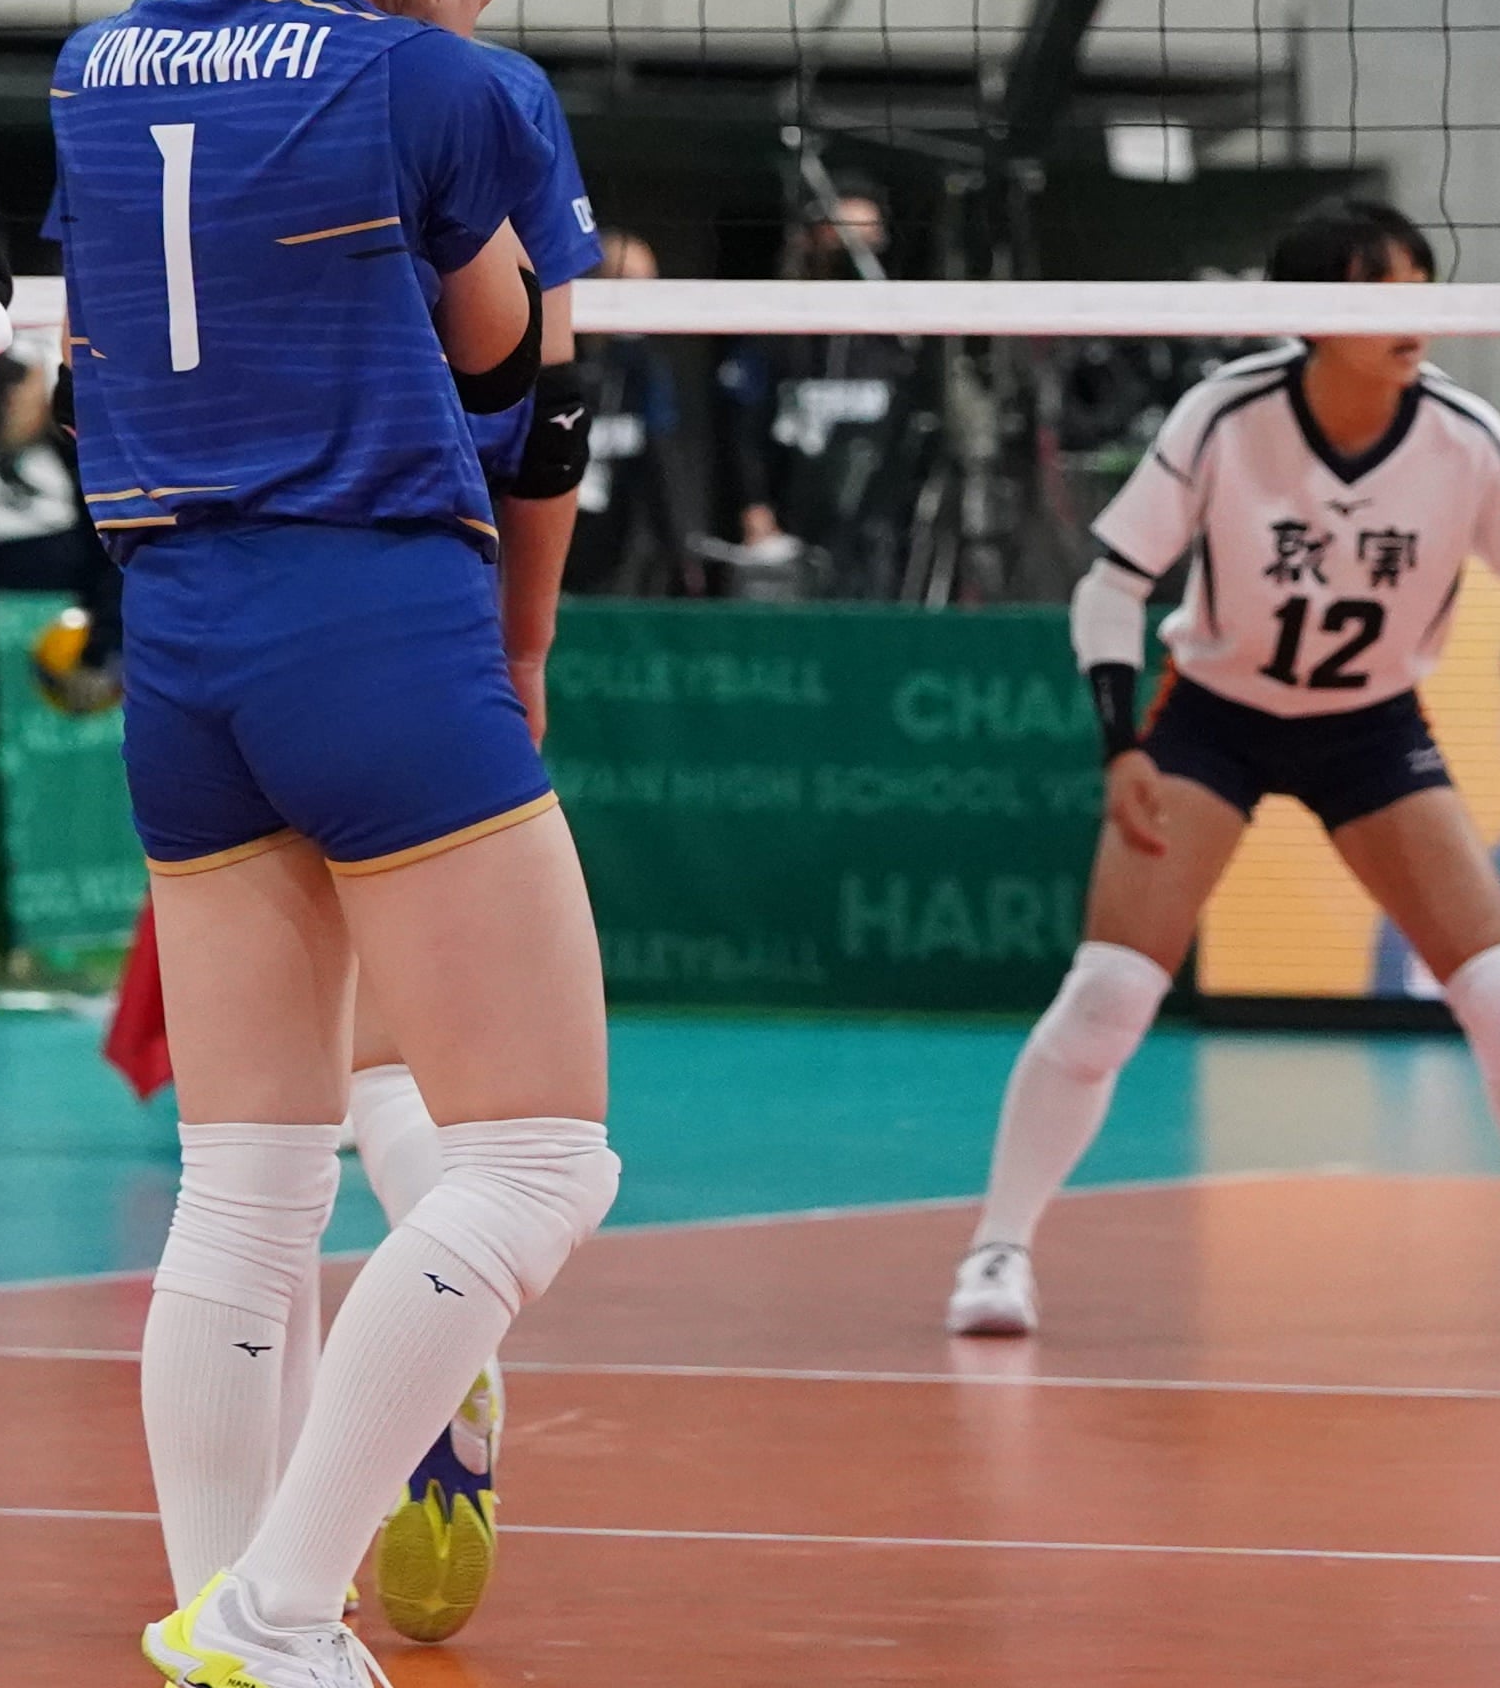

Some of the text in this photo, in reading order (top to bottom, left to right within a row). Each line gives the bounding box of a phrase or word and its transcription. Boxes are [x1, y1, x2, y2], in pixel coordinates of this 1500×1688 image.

[83, 23, 331, 88] KINRANKAI
[150, 123, 200, 372] 1
[1258, 596, 1386, 690] 12
